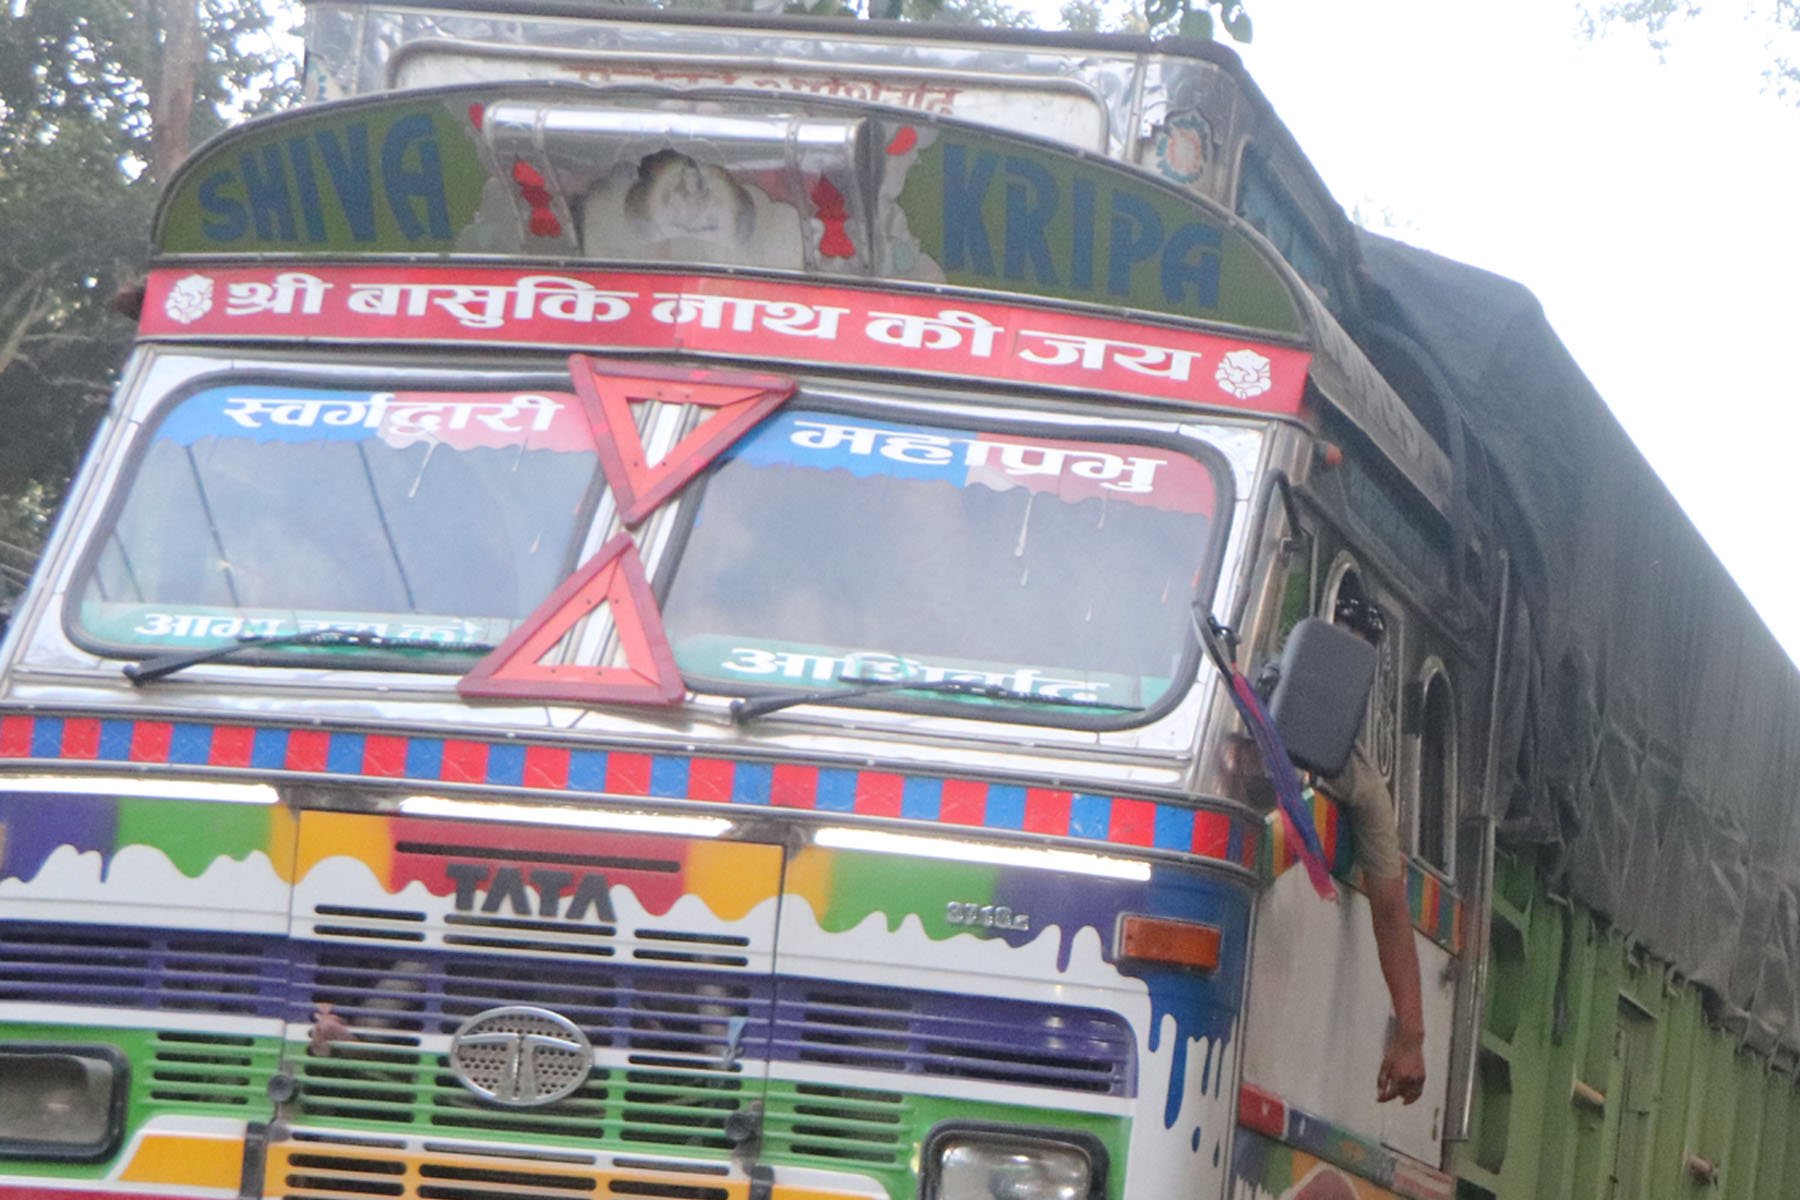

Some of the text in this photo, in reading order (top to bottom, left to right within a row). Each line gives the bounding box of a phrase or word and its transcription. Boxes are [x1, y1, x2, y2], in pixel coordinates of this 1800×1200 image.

[198, 112, 1223, 311] SHIVA KRIPA
[225, 273, 1202, 383] श्री बासुकि नाथ की जय
[223, 391, 1168, 493] स्वर्गद्वारी महाप्रभु
[446, 863, 617, 923] TATA
